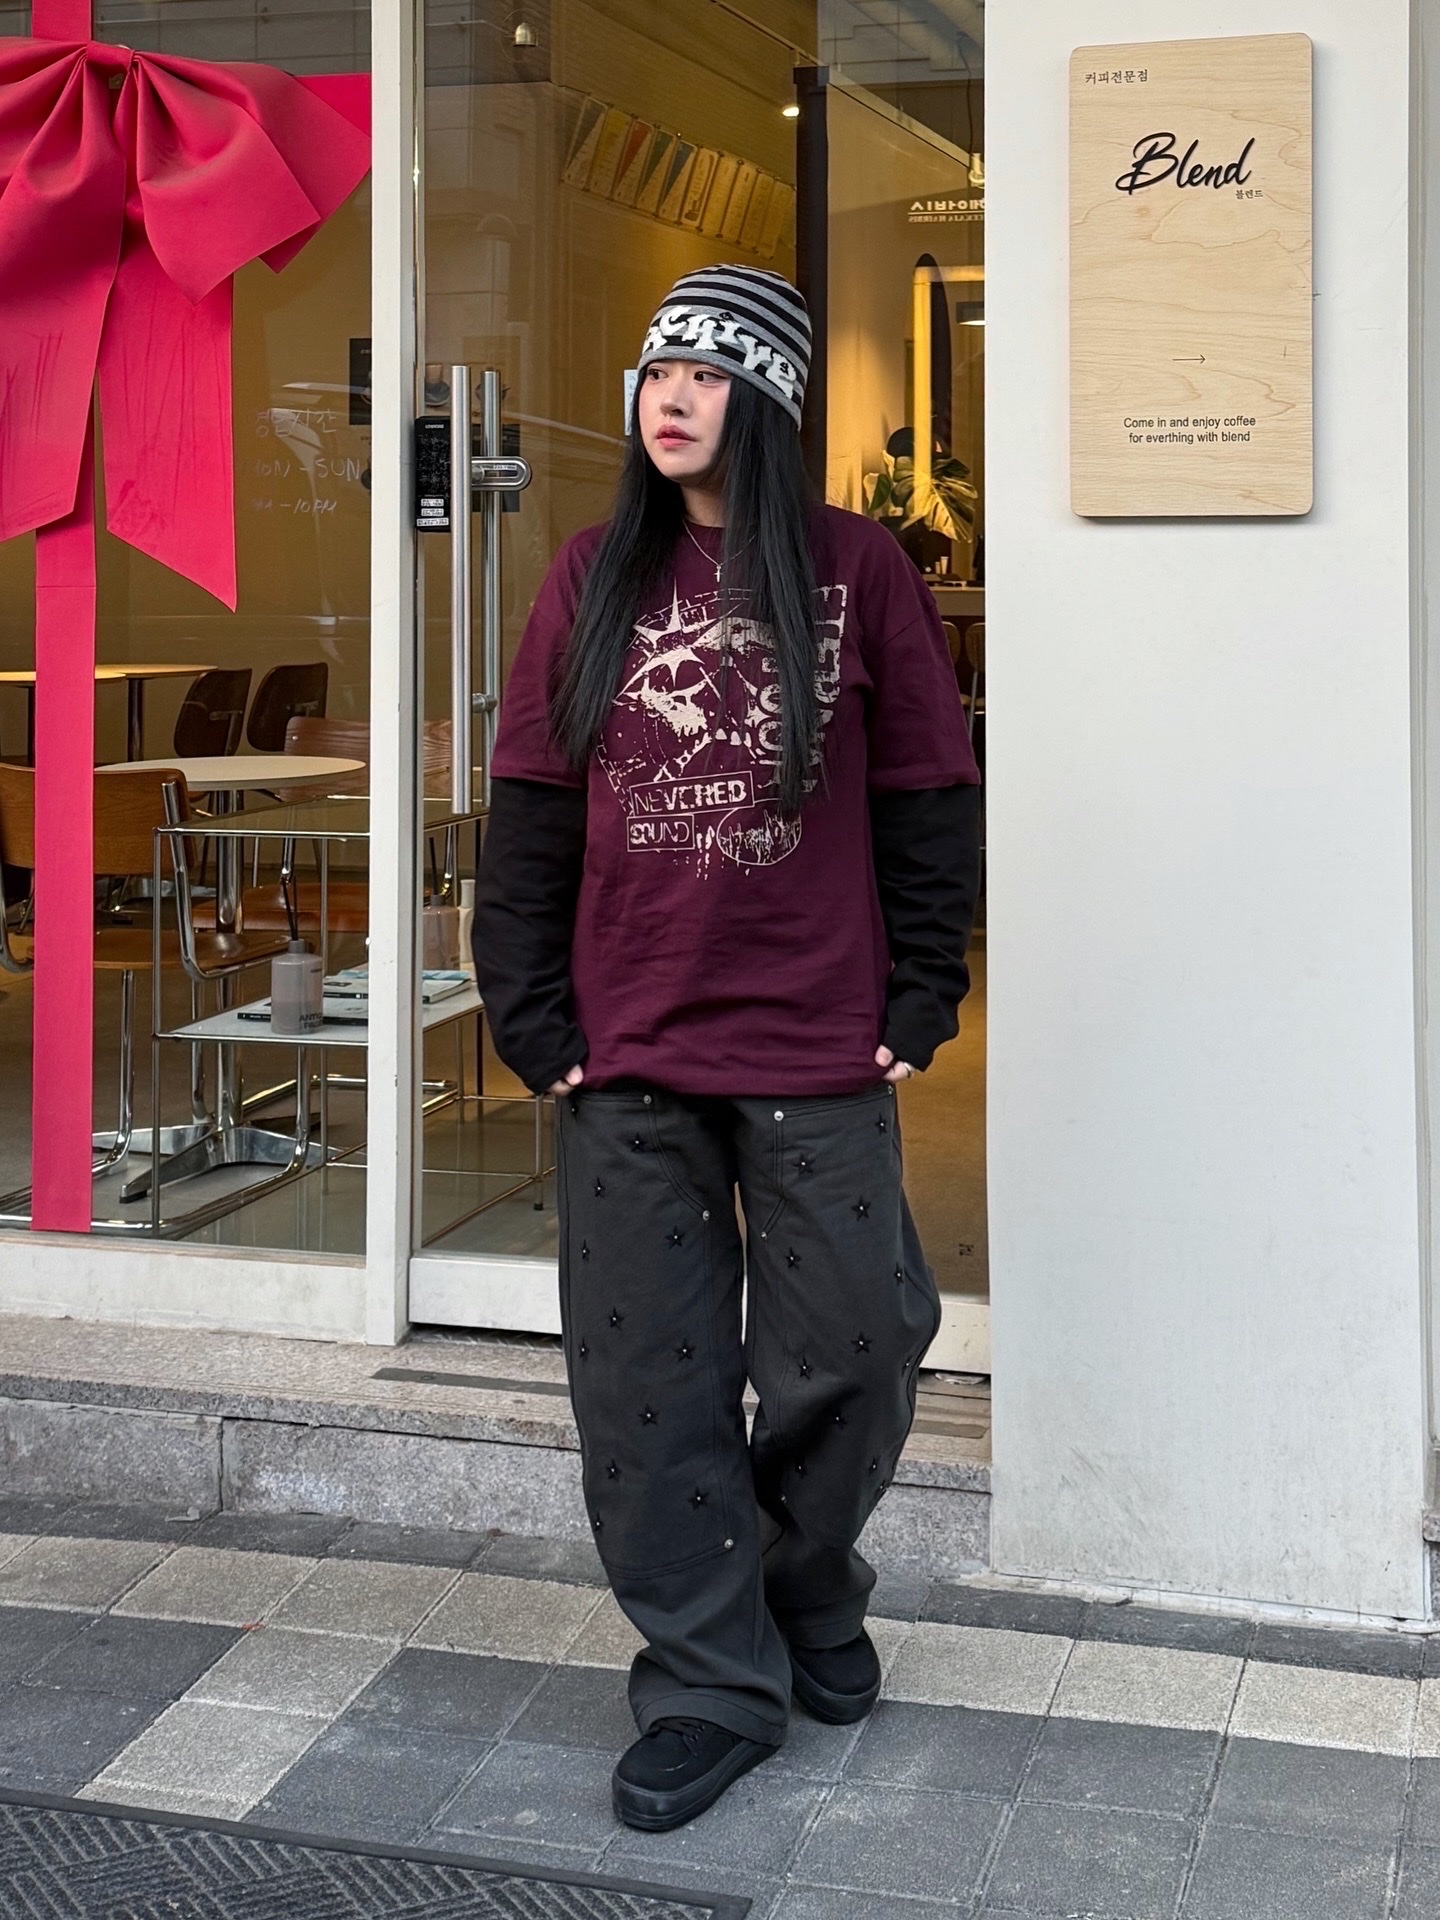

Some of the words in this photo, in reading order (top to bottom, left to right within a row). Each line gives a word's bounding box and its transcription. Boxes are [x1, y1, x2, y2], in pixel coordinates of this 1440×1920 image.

[1084, 68, 1149, 85] 커피전문점
[1115, 132, 1256, 196] Blend
[1235, 189, 1264, 200] 블렌드
[1123, 417, 1154, 428] Come
[1157, 417, 1167, 428] in
[1169, 417, 1189, 427] and
[1192, 416, 1221, 429] enjoy
[1223, 415, 1257, 427] coffee
[1128, 432, 1144, 443] for
[1145, 432, 1194, 444] everthing
[1196, 431, 1218, 442] with
[1221, 430, 1251, 442] blend
[315, 457, 361, 482] SUN
